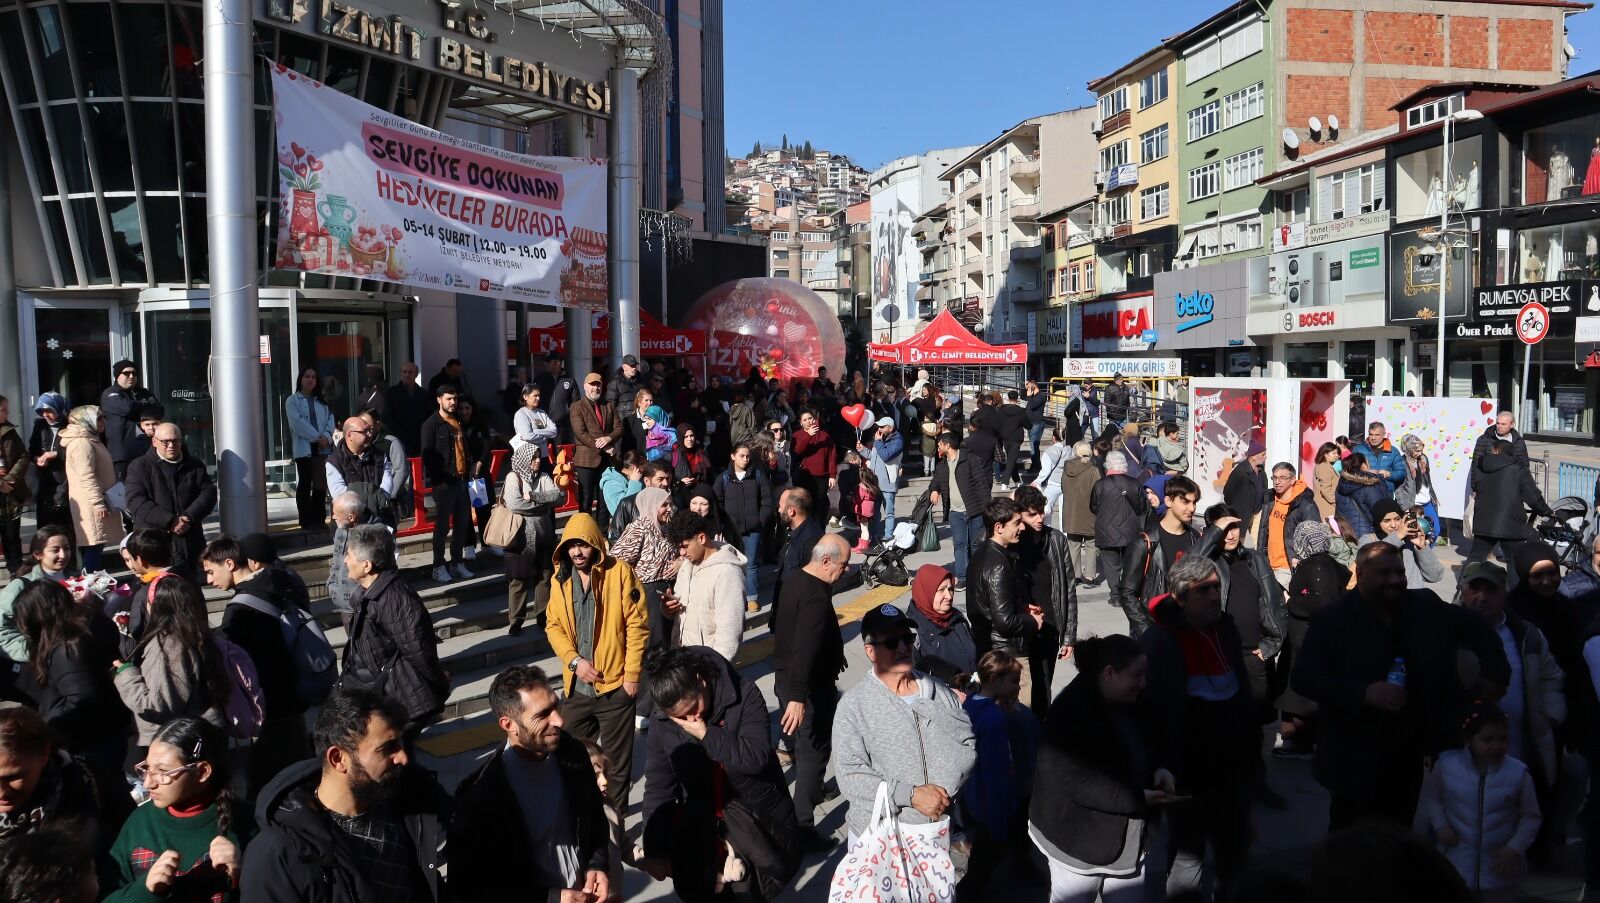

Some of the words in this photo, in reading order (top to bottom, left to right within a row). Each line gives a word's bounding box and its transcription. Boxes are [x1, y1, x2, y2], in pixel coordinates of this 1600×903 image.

[318, 0, 427, 61] İZMİT
[436, 36, 611, 113] BELEDİYESİ
[370, 112, 407, 129] Sevgililer
[368, 134, 460, 181] SEVGİYE
[467, 162, 559, 201] DOKUNAN
[376, 170, 486, 226] HEDİYELER
[491, 203, 568, 239] BURADA
[403, 217, 435, 239] 05-14
[438, 226, 472, 249] ŞUBAT
[479, 238, 507, 255] 12.00
[518, 244, 547, 260] 19.00
[1176, 290, 1214, 317] beko
[1480, 288, 1538, 306] RUMEYSA
[1046, 316, 1063, 331] HALI
[1299, 311, 1335, 328] BOSCH
[1039, 331, 1067, 347] DÜNYAS
[941, 351, 963, 359] İZMİT
[965, 351, 1006, 360] BELEDİYESİ
[1098, 361, 1140, 373] OTOPARK
[1142, 359, 1166, 375] GİRİŞ
